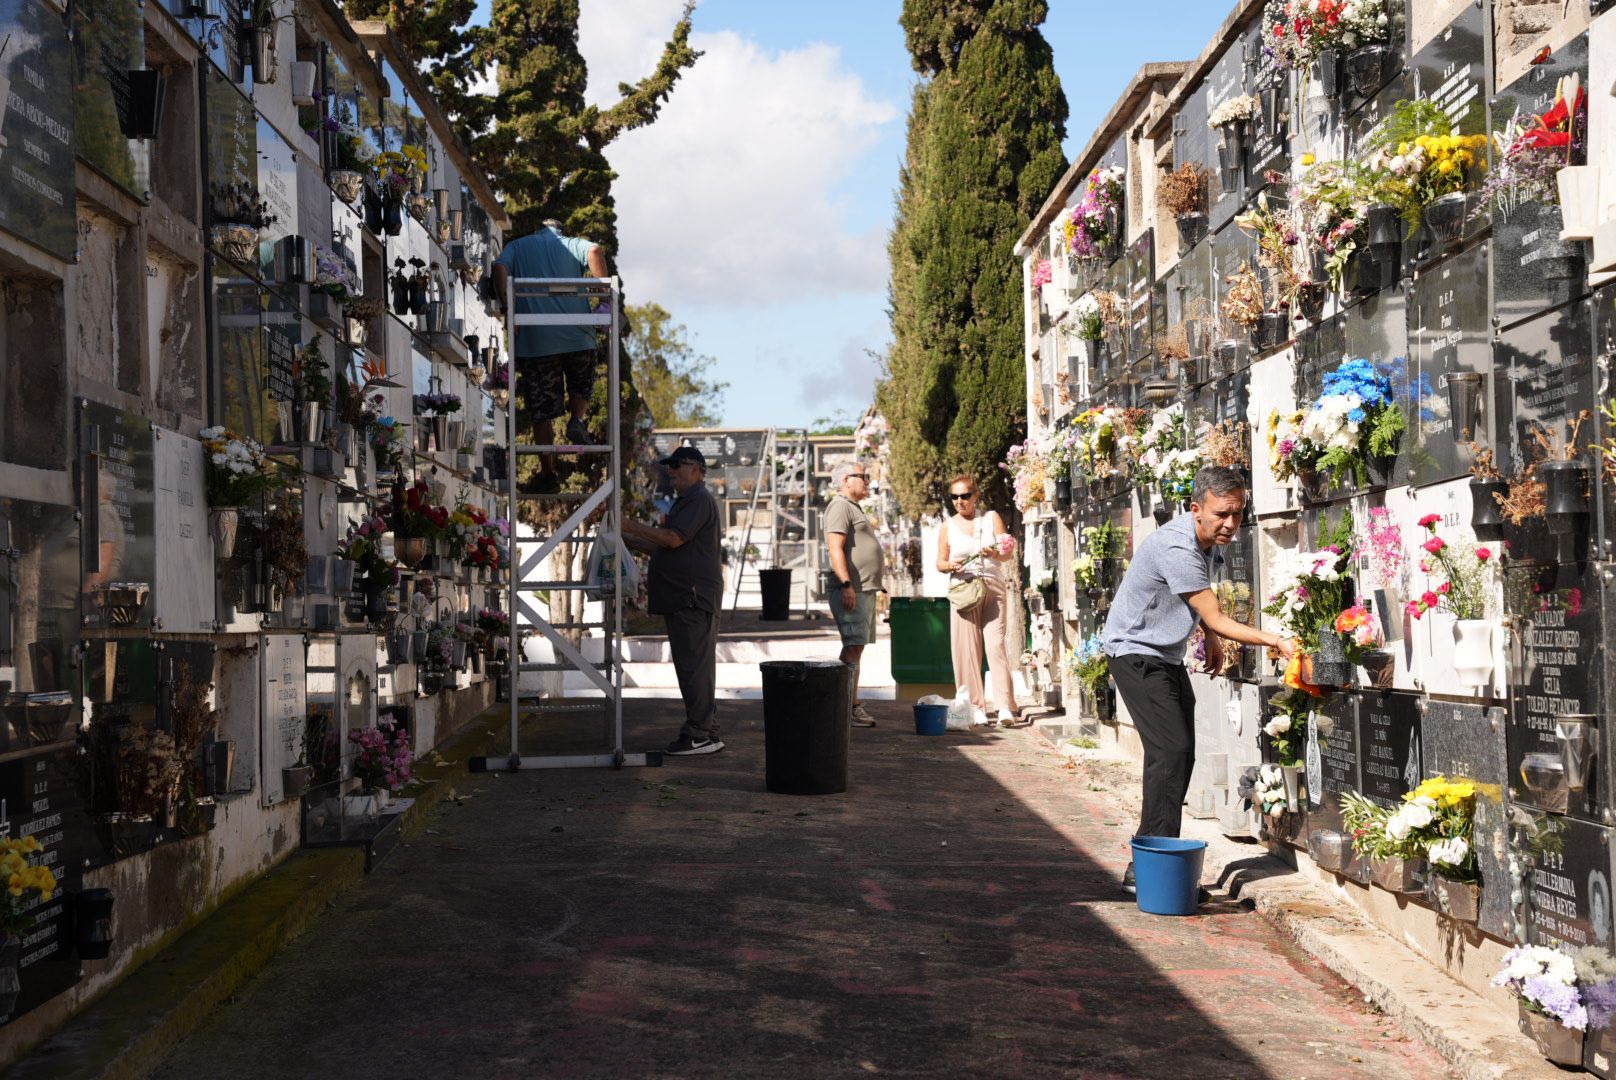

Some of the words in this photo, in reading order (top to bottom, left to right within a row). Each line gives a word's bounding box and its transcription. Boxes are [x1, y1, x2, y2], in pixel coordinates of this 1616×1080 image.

[24, 64, 46, 92] FAMILIA
[1534, 92, 1549, 110] D.E.P.
[24, 139, 43, 162] SIEMPRE
[12, 166, 36, 191] NUESTROS
[37, 181, 64, 206] CORAZONES
[1439, 290, 1454, 308] D.E.P.
[1534, 610, 1565, 627] SALVADOR
[1554, 632, 1580, 648] ROMERO
[1548, 652, 1557, 664] LOS
[1563, 650, 1577, 666] AÑOS
[1543, 678, 1561, 694] CELIA
[1526, 695, 1548, 713] TOLEDO
[1549, 697, 1580, 716] BETANCOR
[1543, 849, 1564, 870] D.E.P.
[1535, 869, 1576, 898] GUILLERMINA
[1556, 897, 1577, 919] REYES
